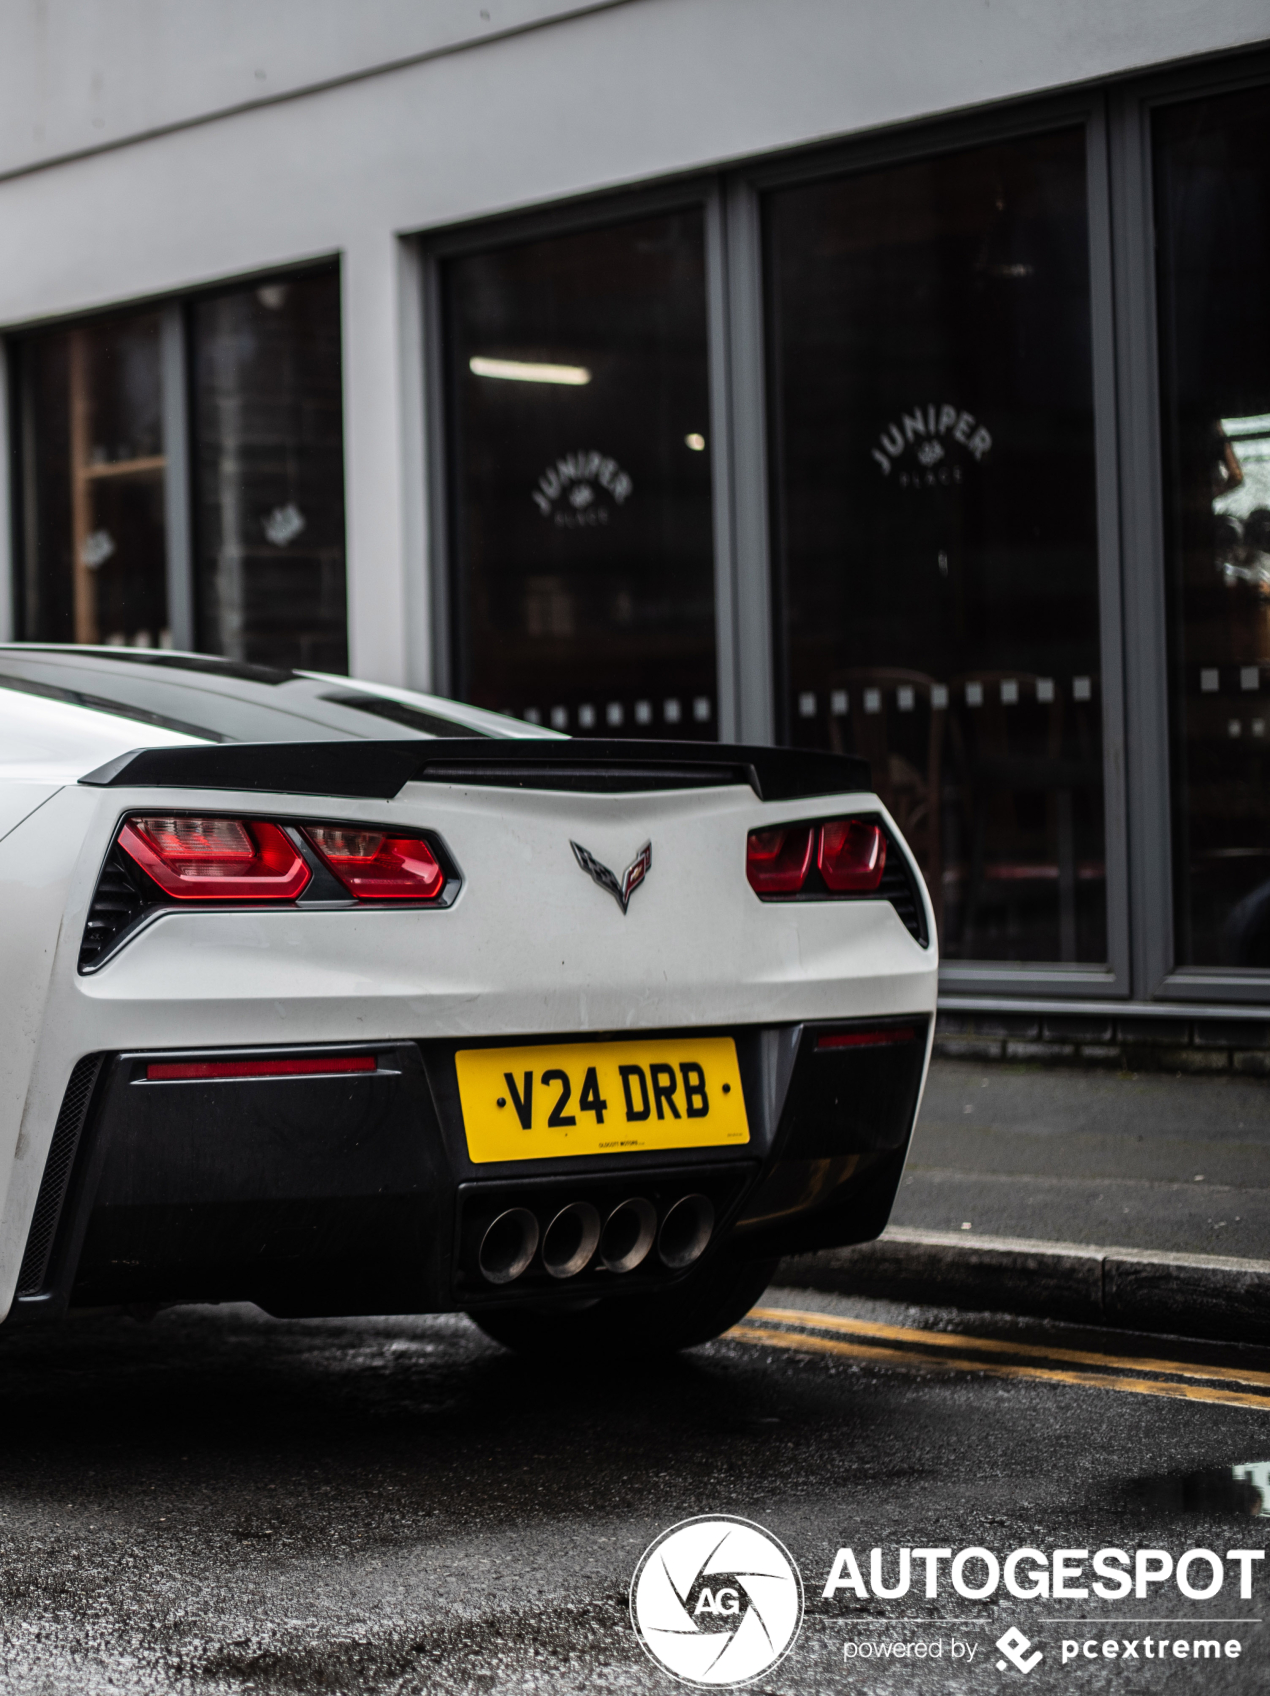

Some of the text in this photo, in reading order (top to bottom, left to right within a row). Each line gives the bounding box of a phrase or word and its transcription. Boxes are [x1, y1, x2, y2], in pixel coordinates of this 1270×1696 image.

[871, 403, 992, 476] JUNIPER
[532, 449, 632, 516] JUNIPER
[503, 1062, 710, 1130] V24 DRB
